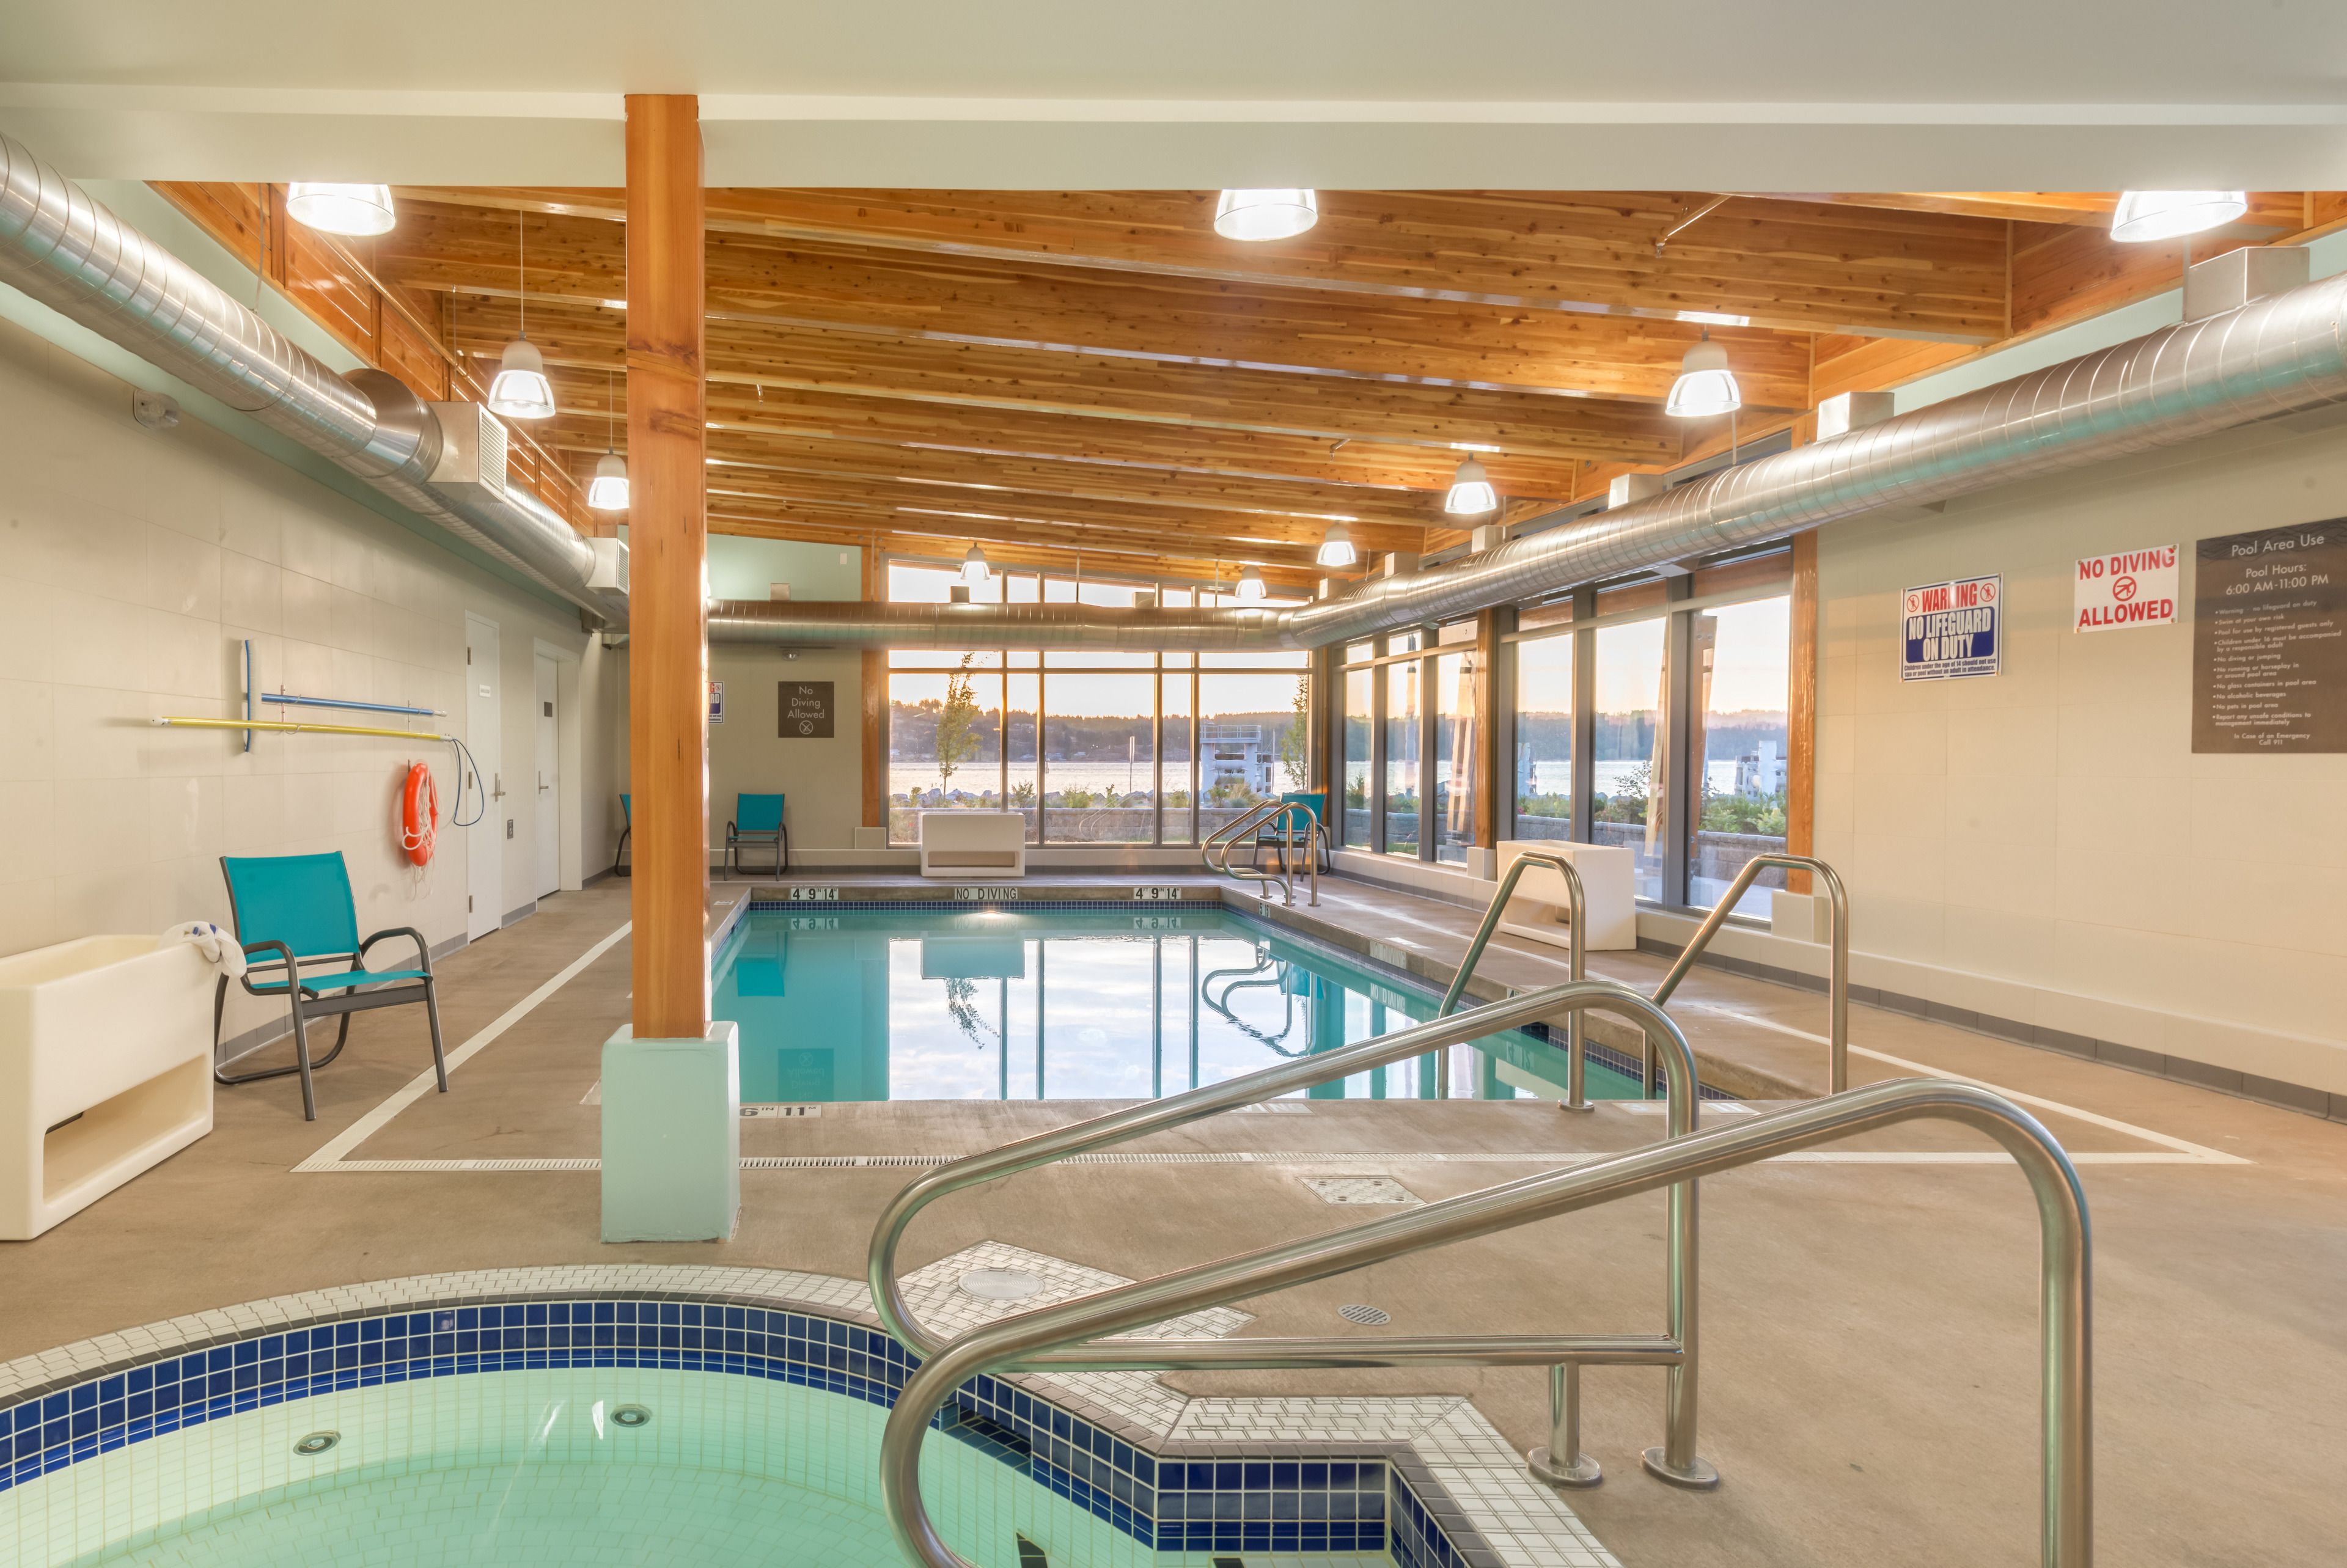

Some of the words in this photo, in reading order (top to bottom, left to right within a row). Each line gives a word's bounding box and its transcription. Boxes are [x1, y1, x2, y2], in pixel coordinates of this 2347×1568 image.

[2232, 540, 2258, 557] Pool
[2263, 540, 2294, 552] Area
[2301, 534, 2324, 546] Use
[2079, 559, 2104, 580] NO
[2110, 548, 2175, 576] DIVING
[2246, 565, 2268, 578] Pool
[2272, 564, 2307, 575] Hours:
[2226, 584, 2250, 595] 6:00
[2312, 574, 2329, 585] PM
[2079, 599, 2173, 627] ALLOWED
[1909, 617, 1924, 640] NO
[1926, 607, 1991, 639] LIFEGUARD
[2264, 622, 2295, 632] registered
[2299, 630, 2341, 639] accompanied
[1923, 637, 1939, 662] ON
[1941, 633, 1974, 659] DUTY
[2231, 643, 2265, 651] responsible
[2285, 679, 2299, 687] pool
[799, 686, 814, 695] No
[792, 698, 821, 709] Diving
[787, 709, 825, 719] Allowed
[793, 888, 800, 899] 4
[809, 888, 816, 899] 9
[957, 888, 969, 899] NO
[978, 888, 1016, 899] DIVING
[1136, 888, 1143, 899] 4
[1151, 888, 1159, 899] 9
[740, 1107, 758, 1116] 6
